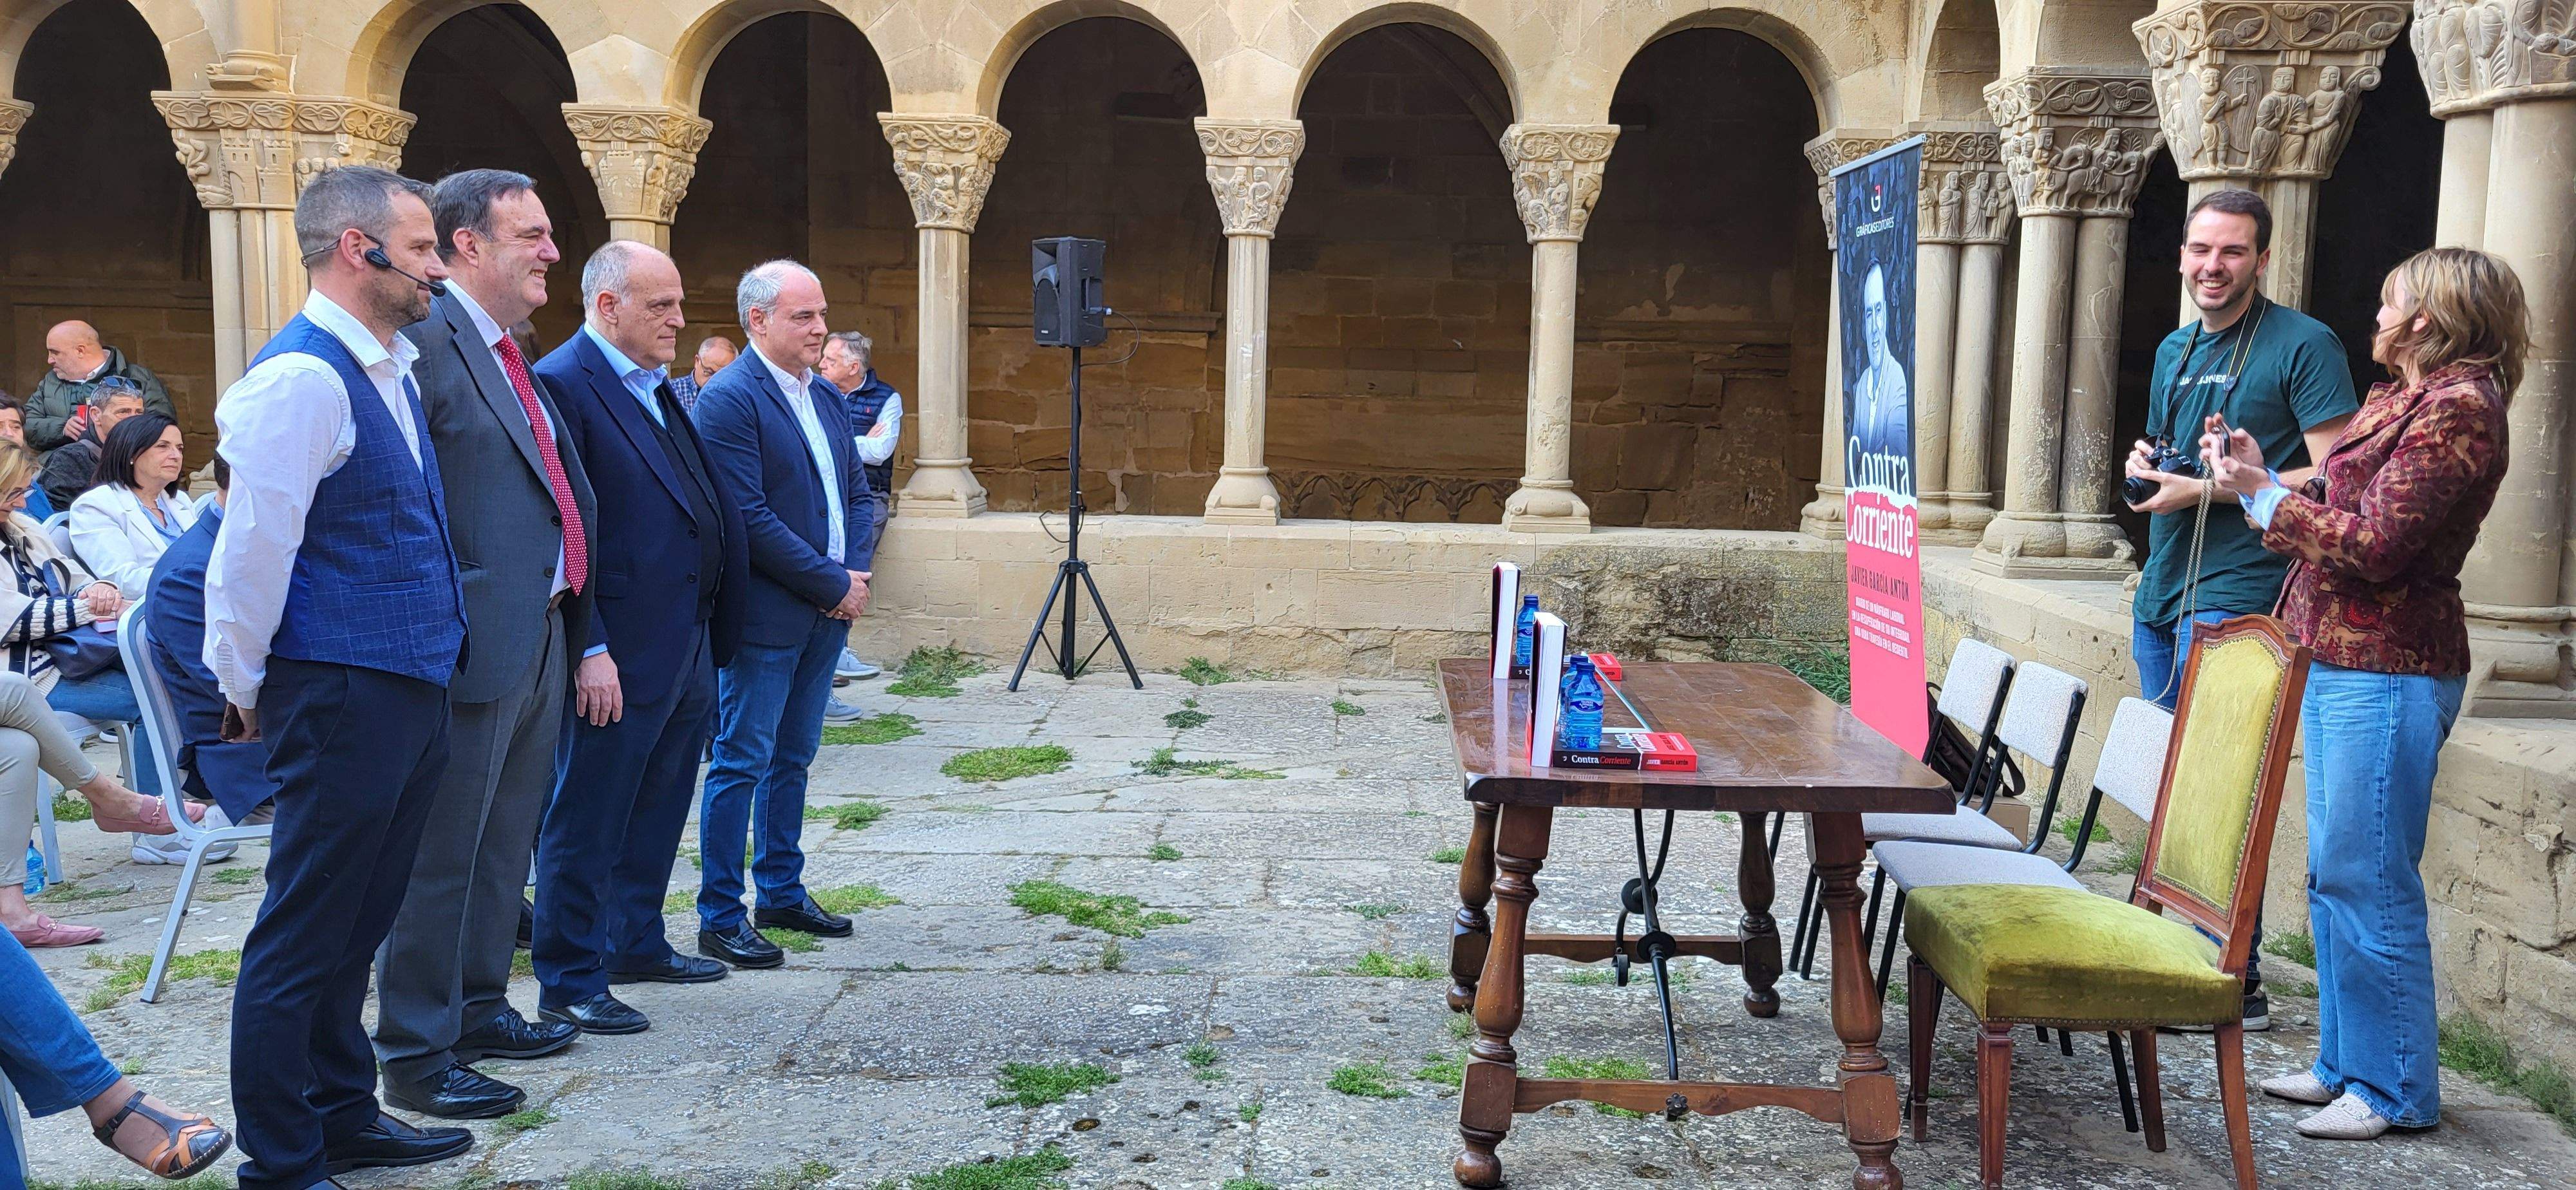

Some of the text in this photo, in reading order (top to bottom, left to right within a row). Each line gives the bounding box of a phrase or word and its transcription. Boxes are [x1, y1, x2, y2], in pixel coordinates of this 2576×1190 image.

[2179, 374, 2227, 386] JAJONES
[1849, 435, 1910, 496] Contra
[1846, 492, 1913, 558] Corriente
[1851, 564, 1909, 602] JAVIER GARCÍA ANTÓN
[1571, 755, 1599, 764] Contra
[1600, 756, 1631, 765] Corriente
